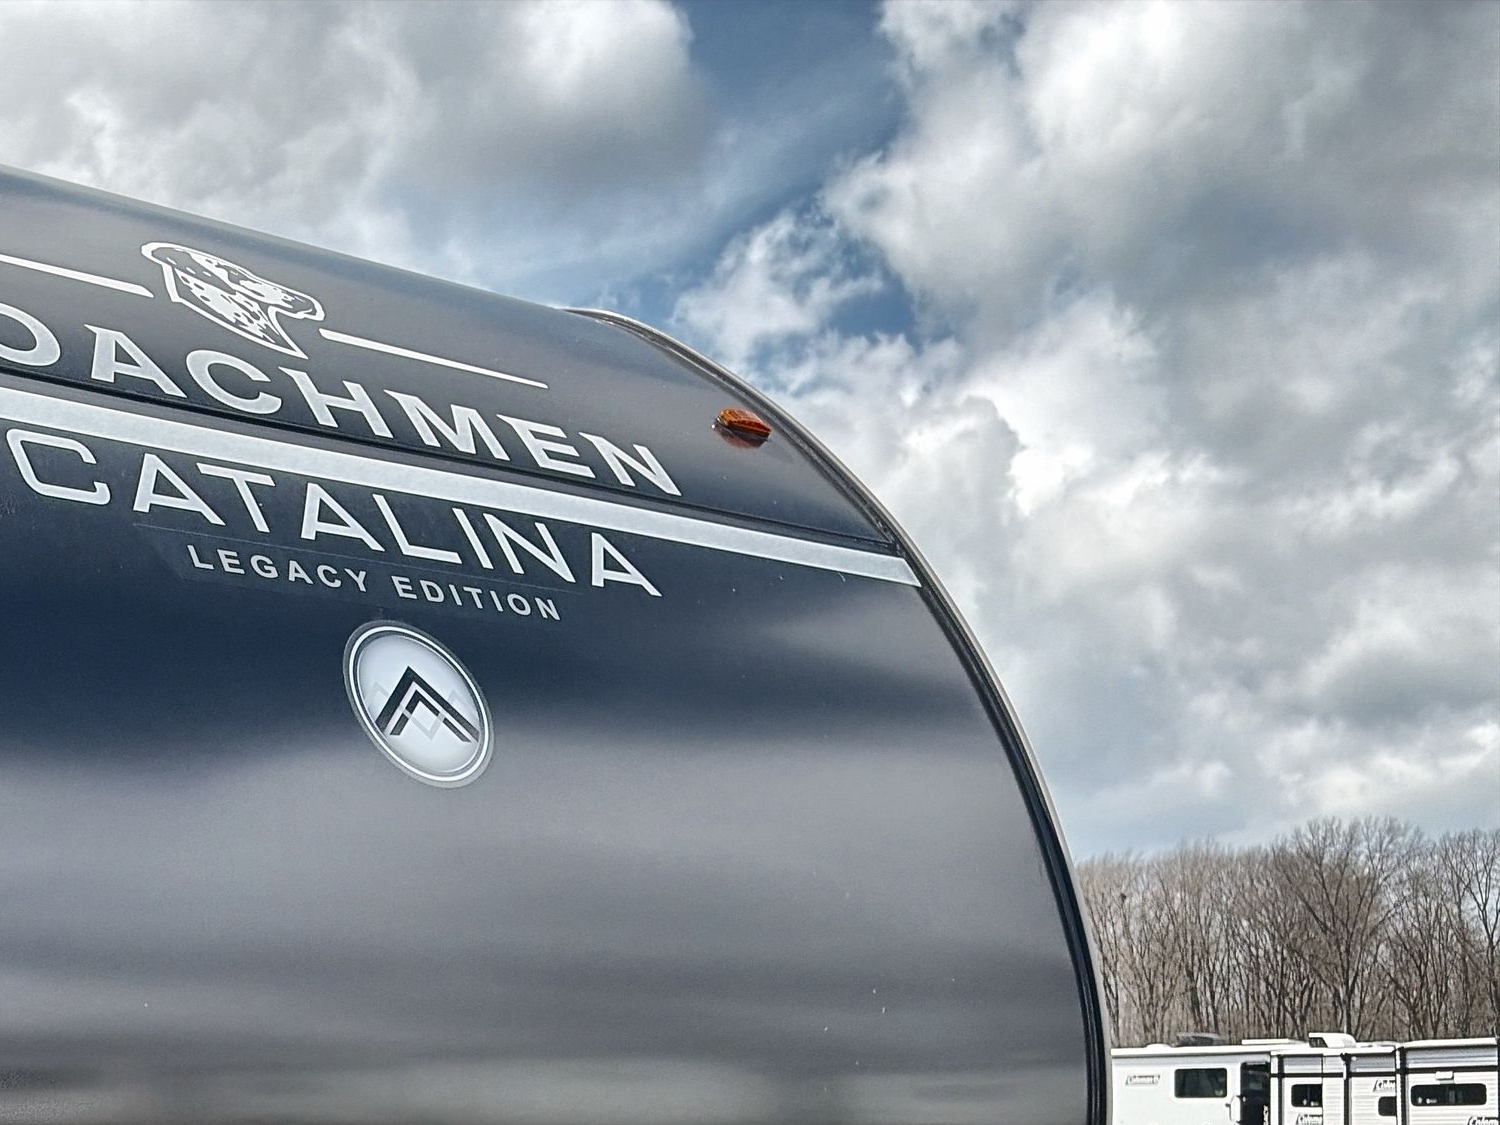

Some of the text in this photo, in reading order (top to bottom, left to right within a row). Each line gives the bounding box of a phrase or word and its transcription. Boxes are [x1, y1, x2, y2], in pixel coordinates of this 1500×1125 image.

[6, 428, 662, 597] CATALINA
[186, 544, 562, 621] LEGACY EDITION
